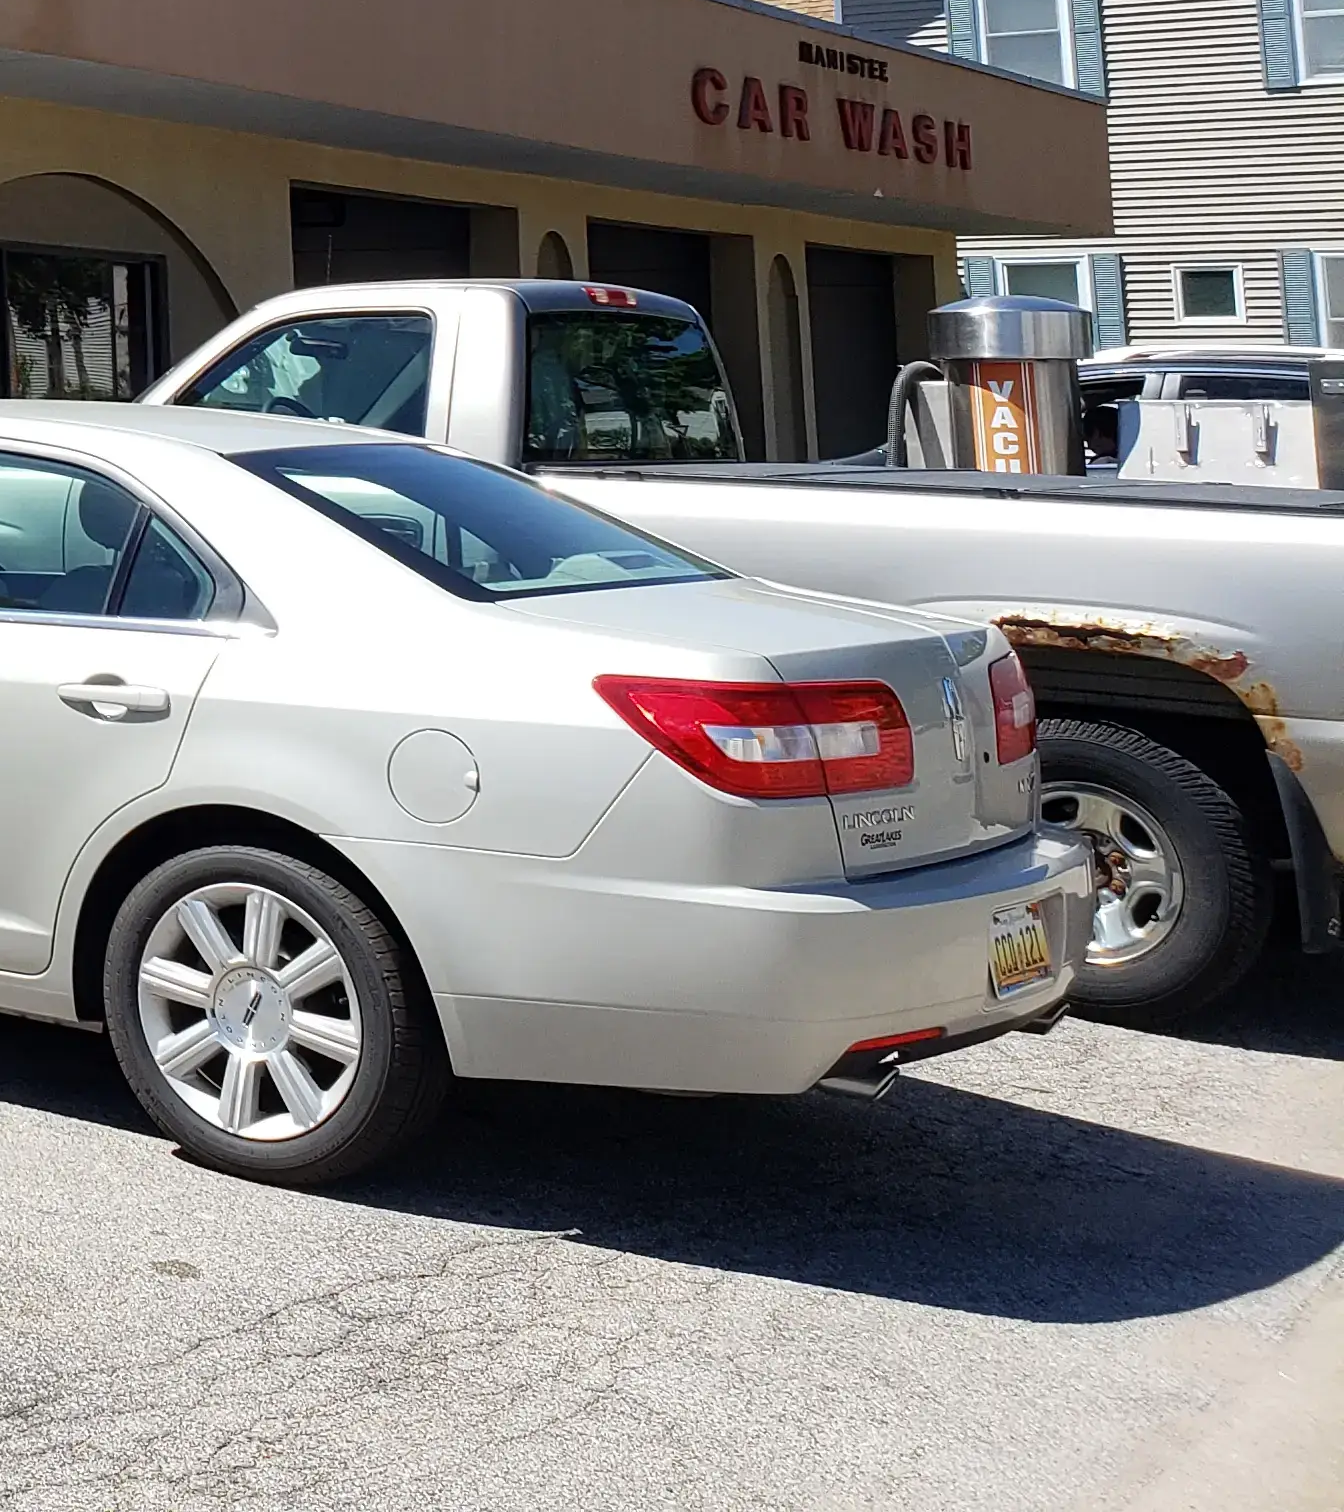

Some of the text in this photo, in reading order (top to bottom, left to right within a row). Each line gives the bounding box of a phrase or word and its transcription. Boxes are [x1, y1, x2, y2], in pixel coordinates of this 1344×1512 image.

[798, 41, 889, 82] MANISTEE
[691, 67, 972, 170] CAR WASH
[842, 805, 916, 830] LINCOLN
